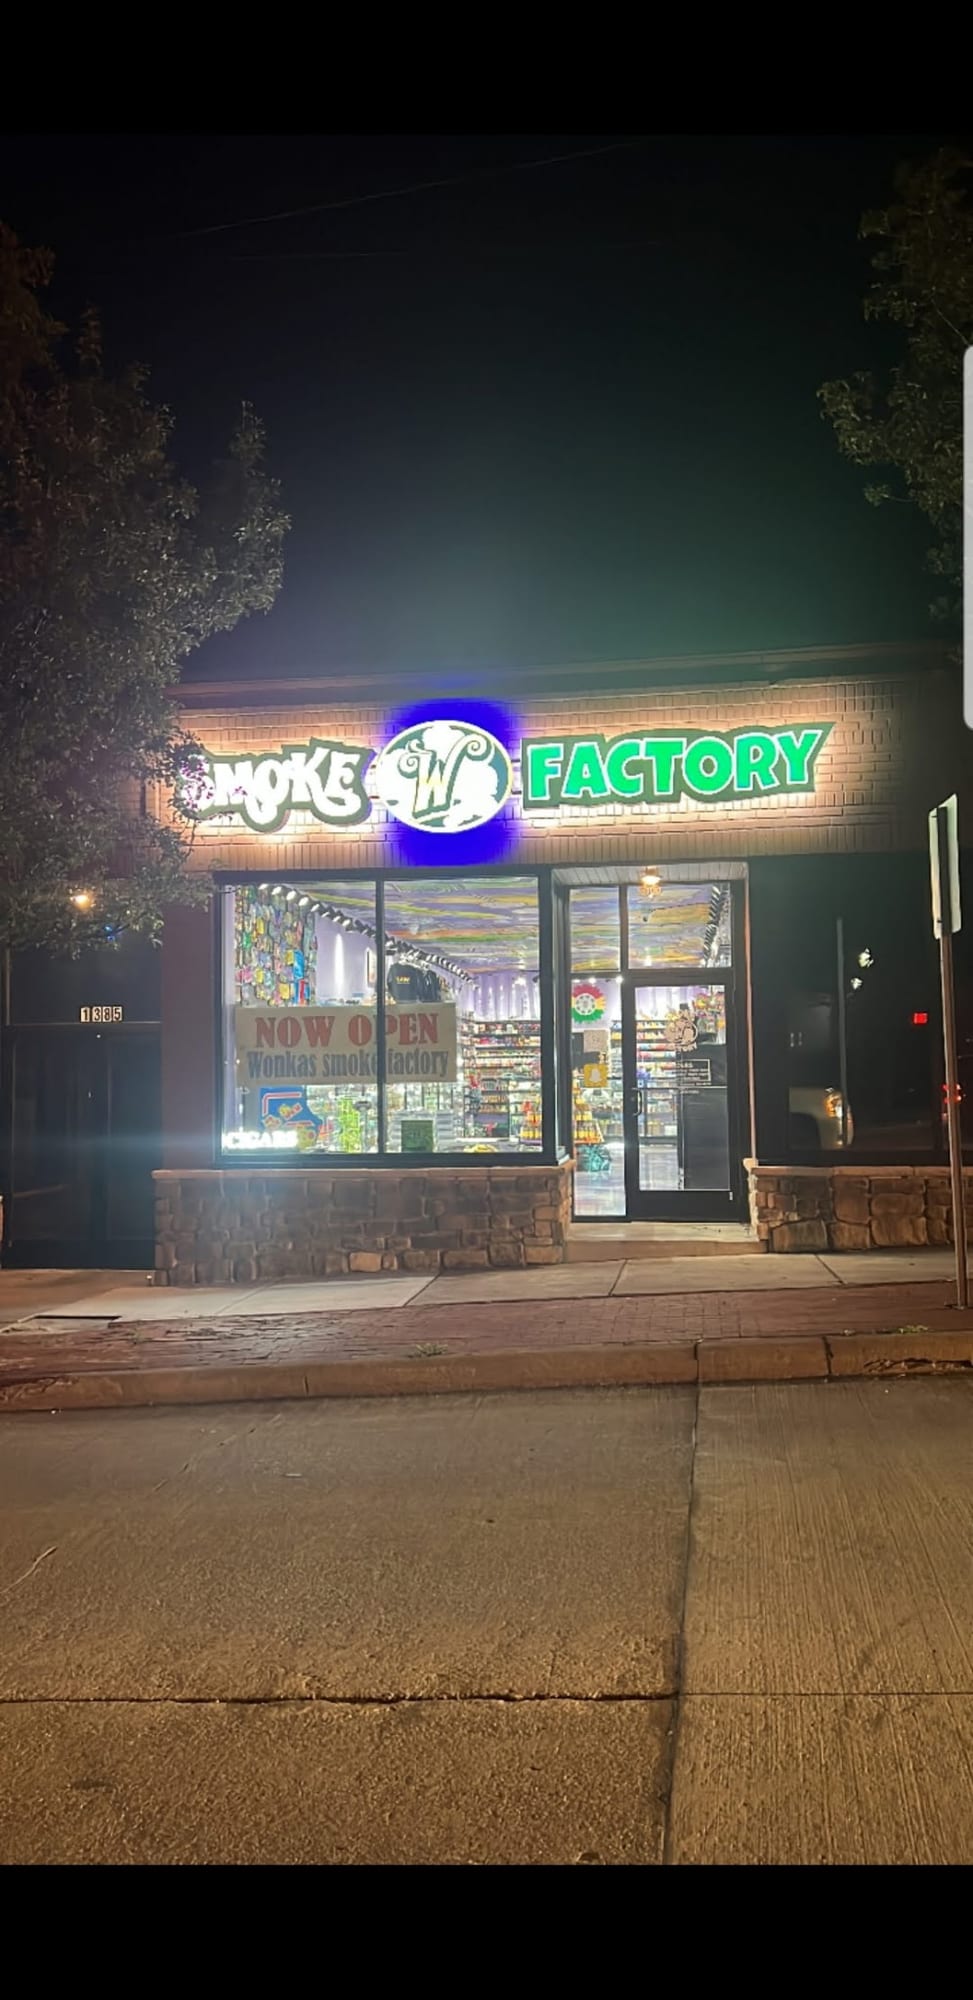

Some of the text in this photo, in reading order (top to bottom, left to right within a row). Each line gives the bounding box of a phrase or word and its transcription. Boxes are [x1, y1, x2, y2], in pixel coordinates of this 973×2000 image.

[180, 730, 822, 825] SMOKE W FACTORY
[83, 1008, 121, 1021] 1385
[255, 1013, 439, 1048] NOW OPEN
[246, 1050, 318, 1078] Wonkas
[387, 1049, 449, 1077] factory
